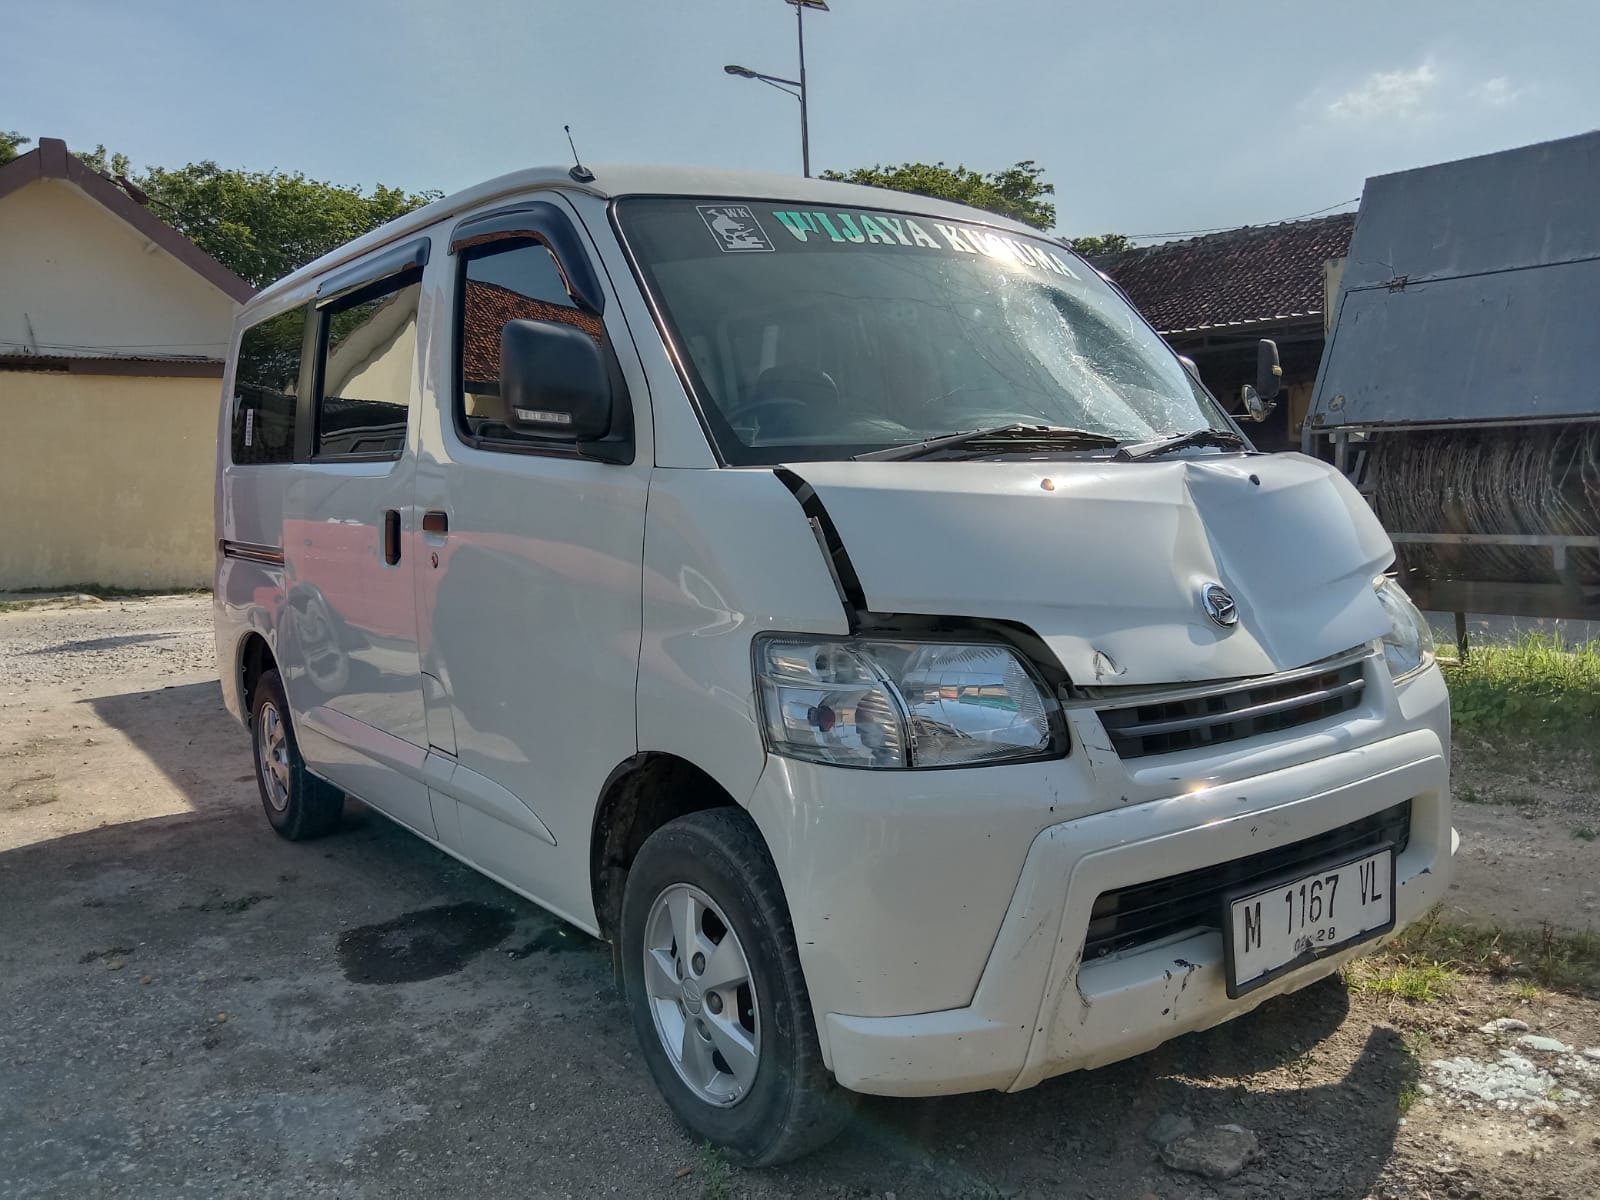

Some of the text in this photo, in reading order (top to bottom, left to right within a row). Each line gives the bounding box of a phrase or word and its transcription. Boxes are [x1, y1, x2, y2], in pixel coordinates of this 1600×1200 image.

[723, 207, 751, 218] WK
[772, 210, 942, 249] WIJAYA
[1244, 860, 1382, 953] M 1167 VL
[1316, 926, 1336, 941] 28
